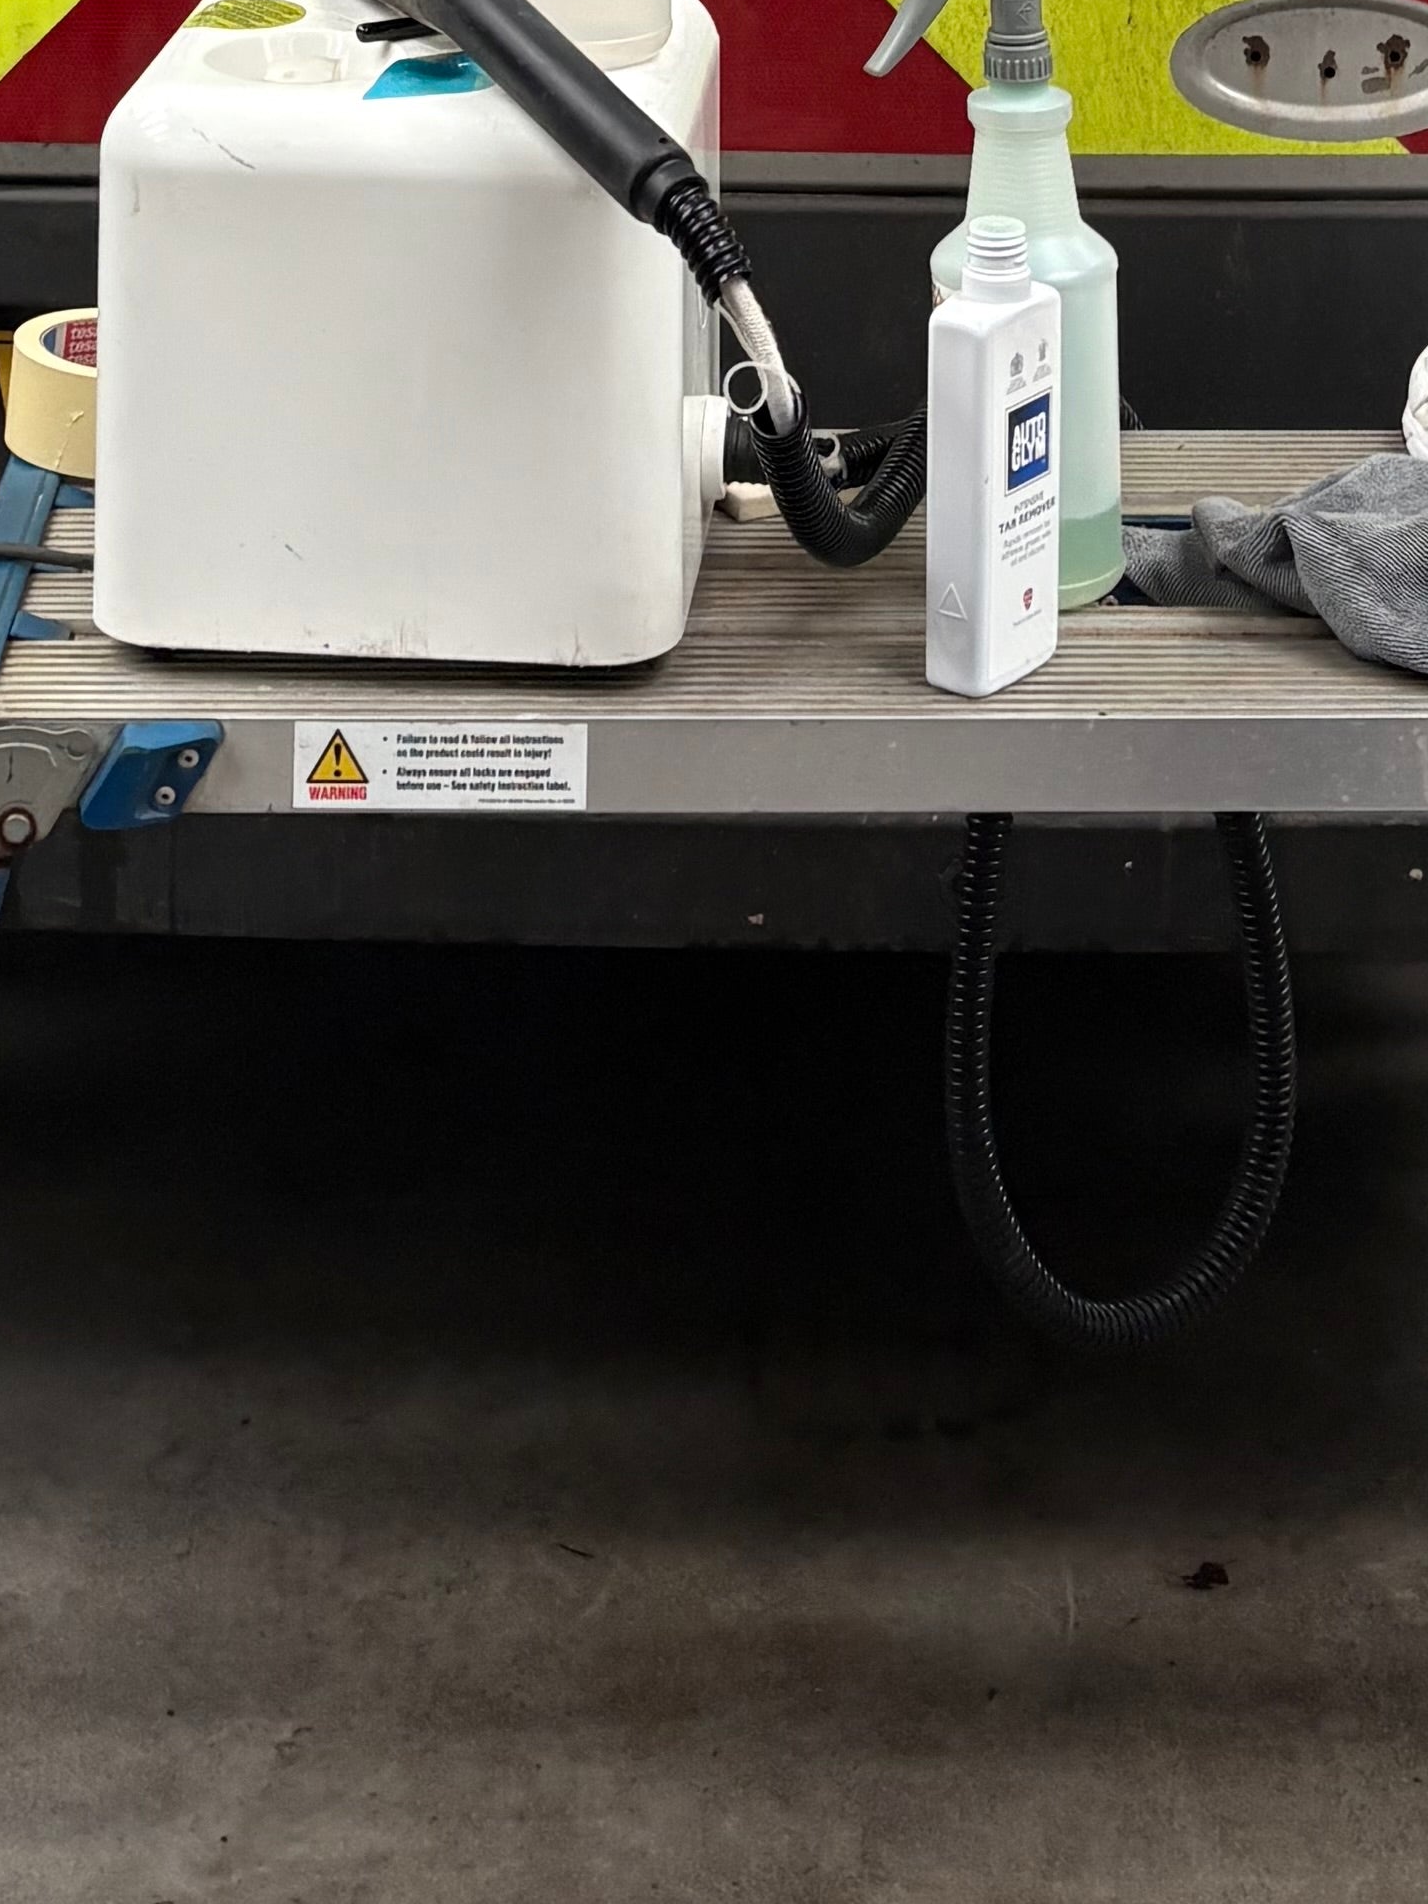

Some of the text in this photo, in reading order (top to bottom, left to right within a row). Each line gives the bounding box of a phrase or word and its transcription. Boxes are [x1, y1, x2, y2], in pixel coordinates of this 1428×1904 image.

[1012, 412, 1046, 446] AUTO
[1011, 436, 1046, 473] GLYM
[429, 734, 438, 744] to
[440, 734, 459, 744] read
[499, 734, 510, 744] all
[409, 748, 423, 758] the
[426, 748, 459, 759] product
[460, 748, 485, 758] could
[396, 767, 427, 779] Always
[459, 767, 471, 778] all
[473, 768, 496, 778] locks
[498, 769, 512, 778] are
[514, 768, 551, 780] engaged
[451, 781, 467, 791] See
[308, 786, 368, 801] WARNING
